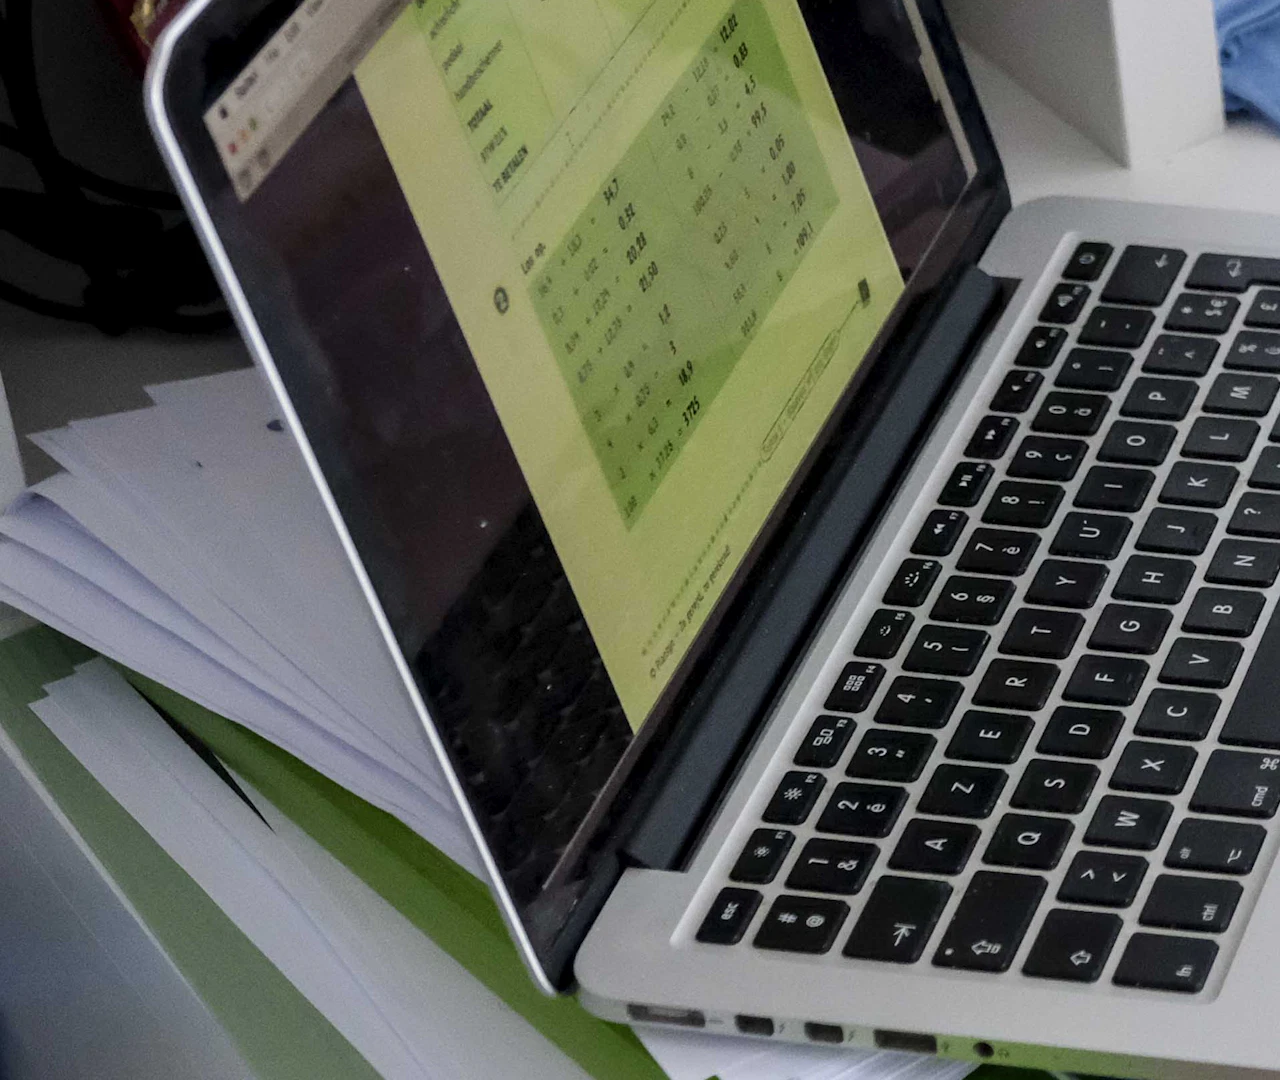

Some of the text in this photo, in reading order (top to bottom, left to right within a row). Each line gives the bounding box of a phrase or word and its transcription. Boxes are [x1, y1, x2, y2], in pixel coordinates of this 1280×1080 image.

[719, 13, 738, 44] 12,02
[732, 41, 749, 69] 0,83
[751, 101, 767, 129] 99,5
[500, 145, 529, 184] BETALEN
[1148, 391, 1166, 401] P
[1230, 386, 1250, 399] M
[1126, 435, 1146, 447] O
[1209, 433, 1230, 441] L
[1025, 450, 1043, 459] 9
[1187, 476, 1208, 488] K
[1001, 496, 1020, 505] 8
[1079, 526, 1101, 538] U
[1167, 524, 1186, 533] J
[975, 542, 994, 552] 7
[1233, 554, 1256, 567] N
[1055, 576, 1076, 586] Y
[1141, 571, 1164, 584] H
[950, 592, 969, 601] 6
[1212, 604, 1233, 615] B
[1030, 625, 1052, 635] T
[1119, 620, 1141, 632] G
[923, 641, 943, 651] 5
[1188, 653, 1210, 664] V
[865, 665, 876, 673] F4
[1005, 677, 1028, 687] R
[1094, 672, 1115, 682] F
[897, 693, 916, 703] 4
[1166, 706, 1188, 717] C
[979, 729, 1001, 739] E
[1068, 723, 1091, 736] D
[867, 747, 888, 757] 3
[1140, 758, 1165, 772] X
[950, 781, 975, 794] Z
[1043, 778, 1066, 789] S
[1251, 785, 1269, 807] cmd
[837, 800, 859, 810] 2
[1114, 810, 1140, 827] W
[924, 838, 948, 851] A
[1017, 831, 1042, 846] Q
[837, 859, 859, 871] &
[721, 902, 739, 920] esc
[1202, 904, 1218, 921] ctrl
[805, 915, 825, 928] @
